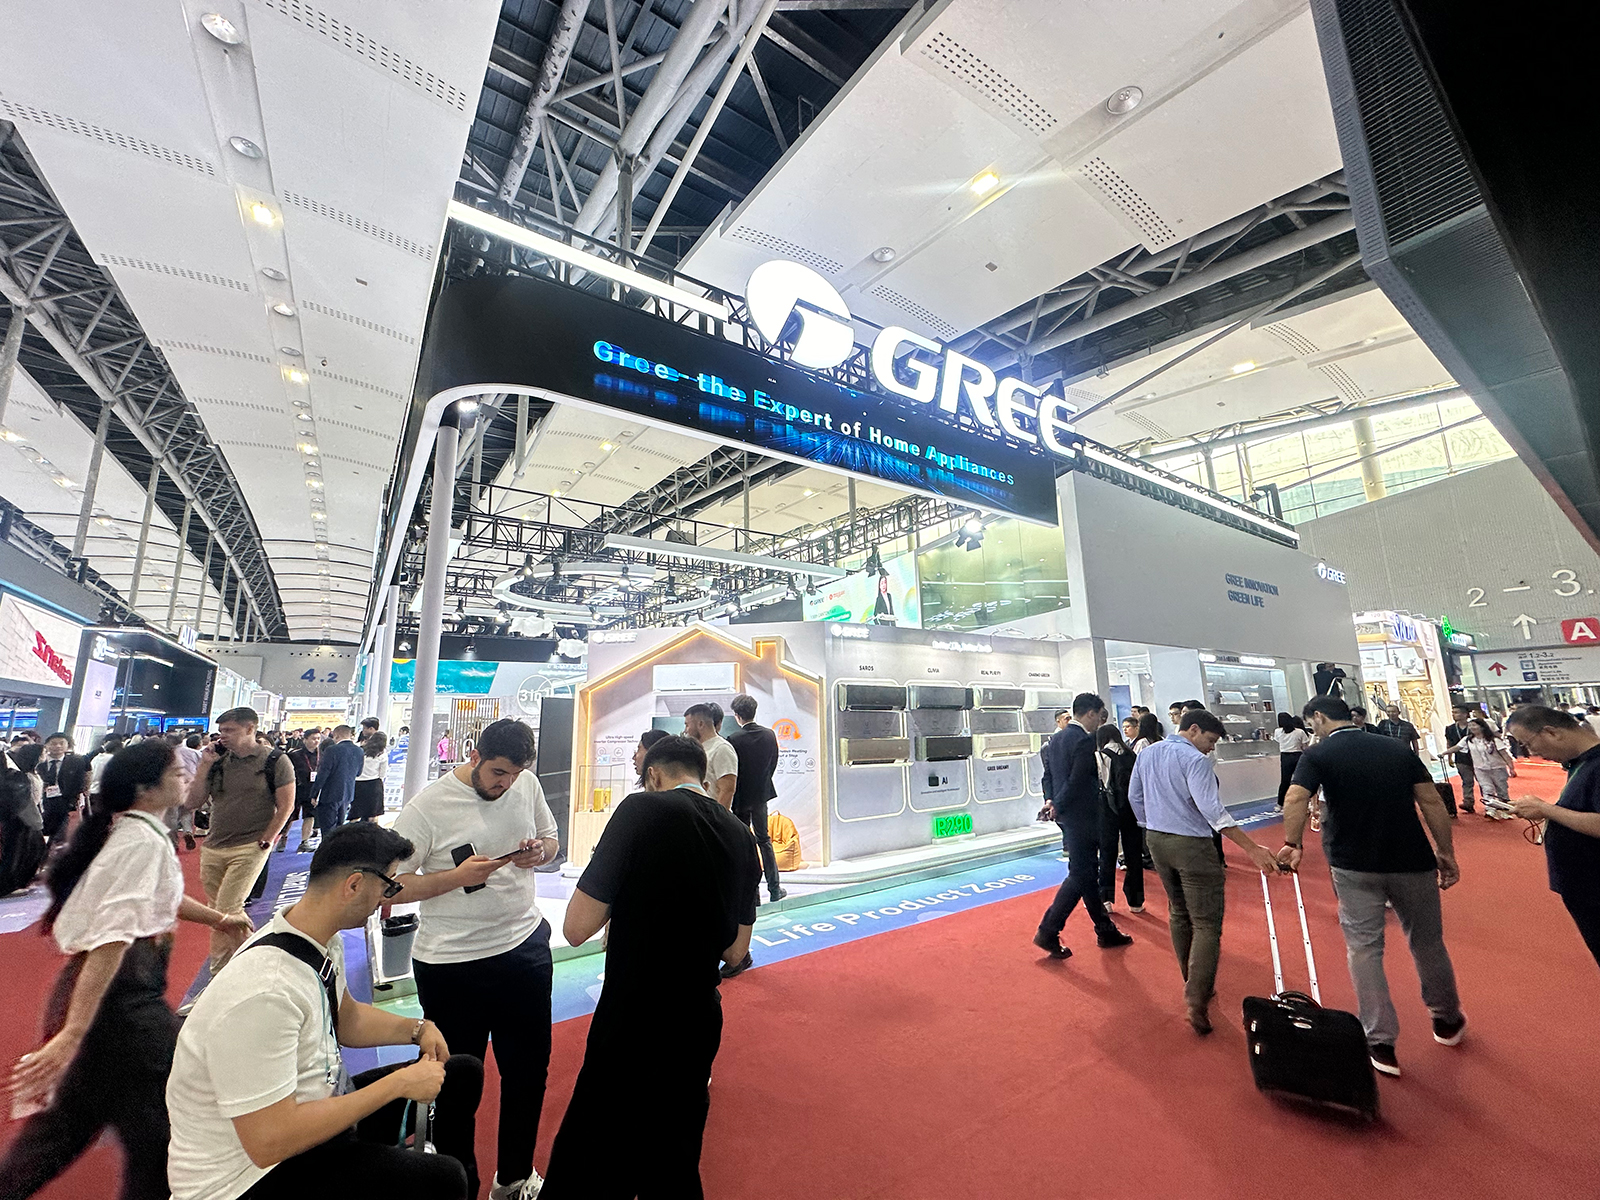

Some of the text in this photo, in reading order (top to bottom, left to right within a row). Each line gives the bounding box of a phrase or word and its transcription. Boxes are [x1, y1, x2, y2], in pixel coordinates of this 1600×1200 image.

[870, 325, 1079, 459] GREE
[753, 389, 833, 430] Expert
[840, 421, 862, 438] of
[868, 426, 921, 457] Home
[925, 445, 1015, 486] Appliances
[1225, 572, 1279, 596] GREE INNOVATION
[1327, 567, 1347, 585] GREE
[1227, 590, 1265, 608] GREEN LIFE
[1571, 621, 1597, 641] A
[301, 668, 338, 683] 4.2
[941, 776, 949, 784] AI
[752, 872, 1036, 947] Life Product Zone
